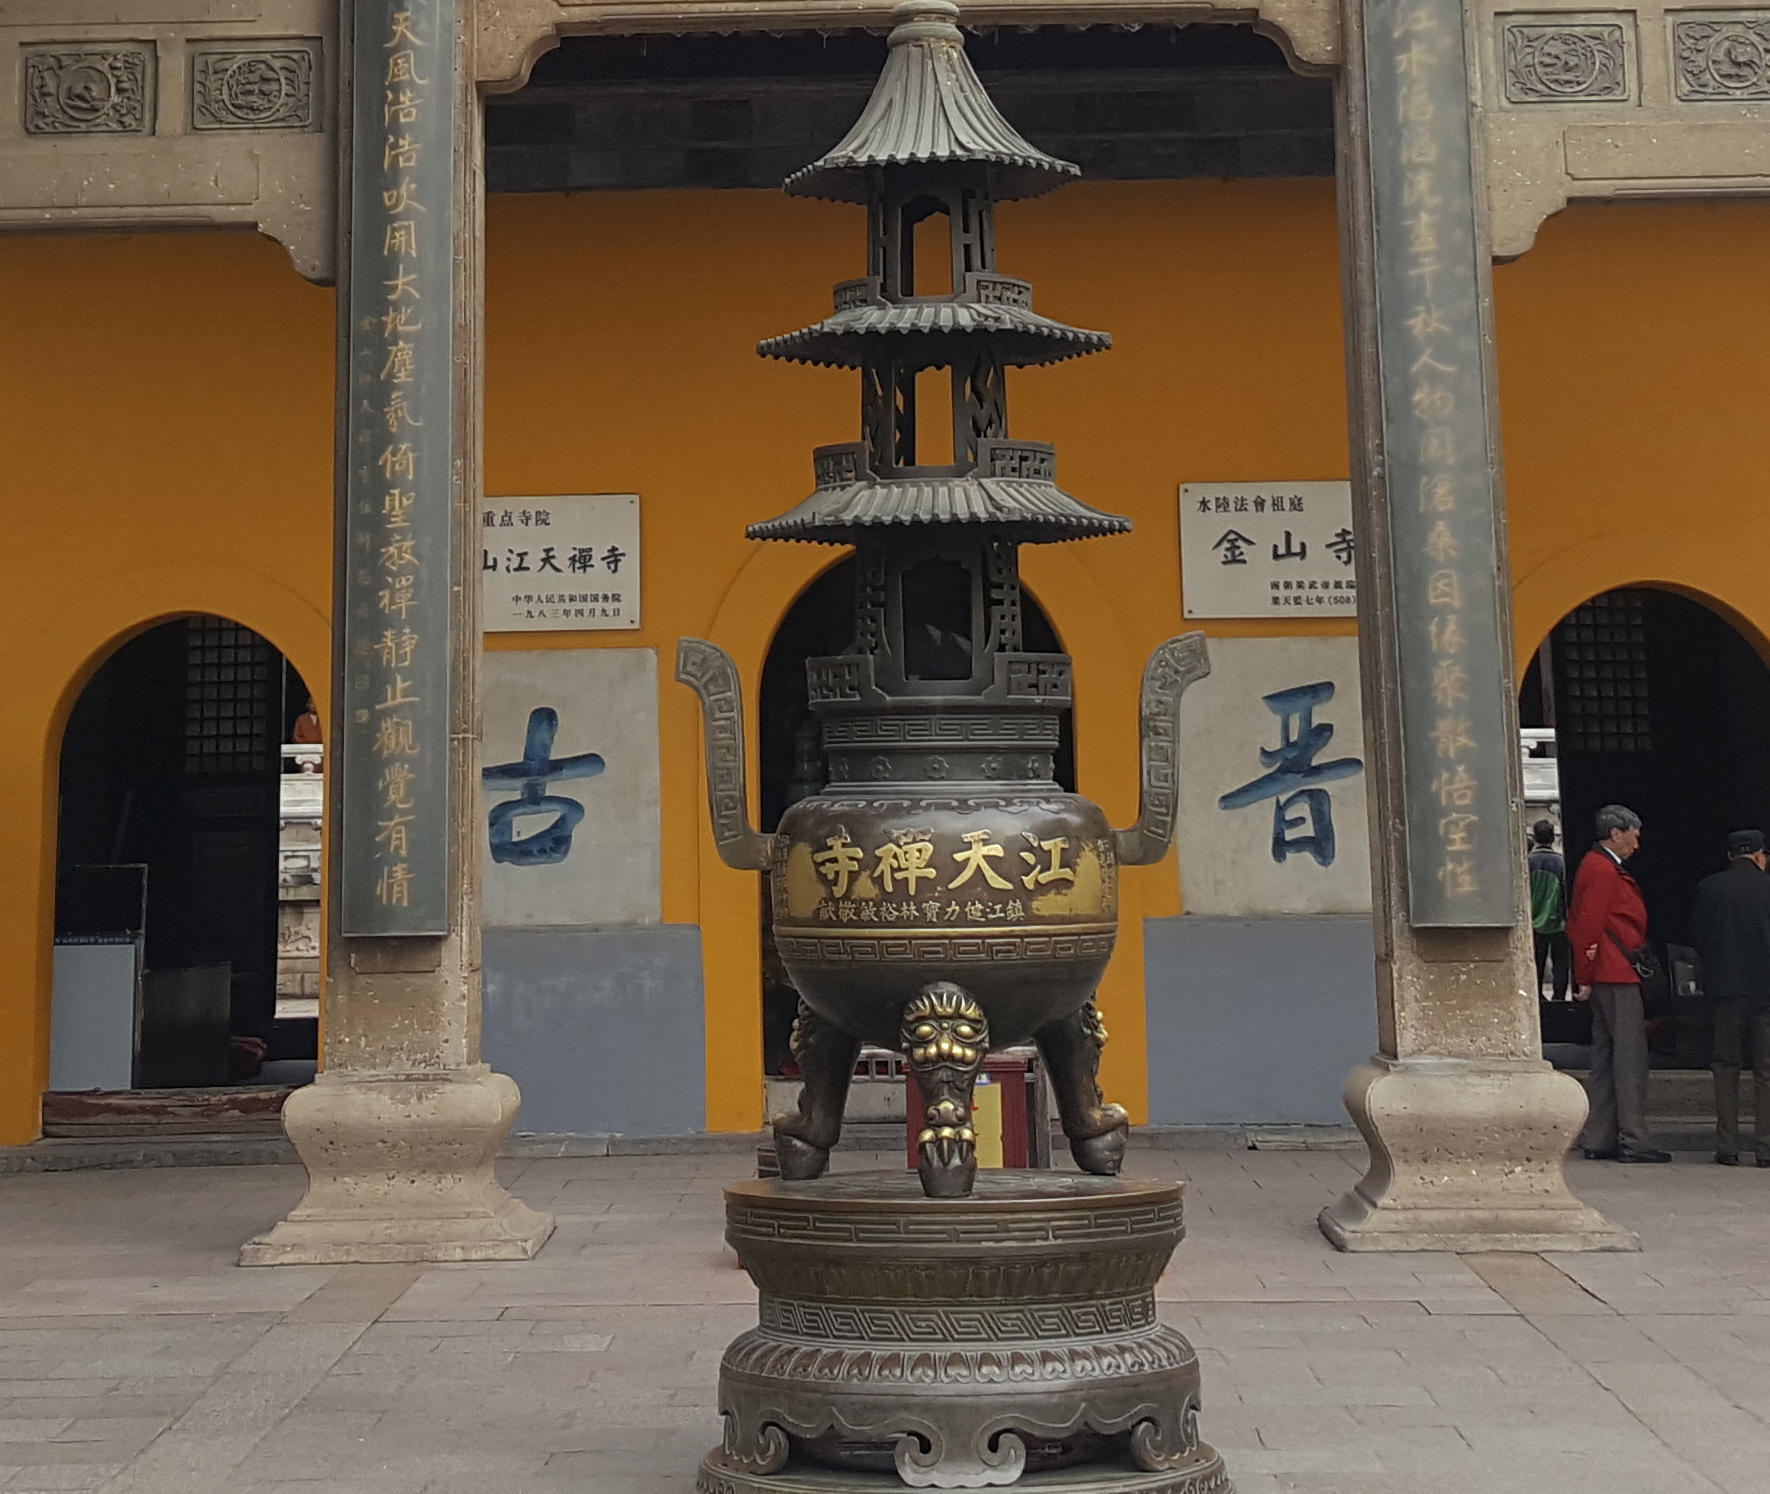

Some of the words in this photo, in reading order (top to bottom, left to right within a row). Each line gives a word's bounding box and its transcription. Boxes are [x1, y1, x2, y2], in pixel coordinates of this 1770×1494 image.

[1197, 495, 1304, 513] 水陸法會祖庭
[483, 509, 551, 527] 重点寺院
[1211, 528, 1355, 566] 金山寺
[512, 593, 622, 604] 中华人民共和国国务院
[512, 608, 621, 618] 一九八三年四月九日
[482, 706, 605, 866] 古
